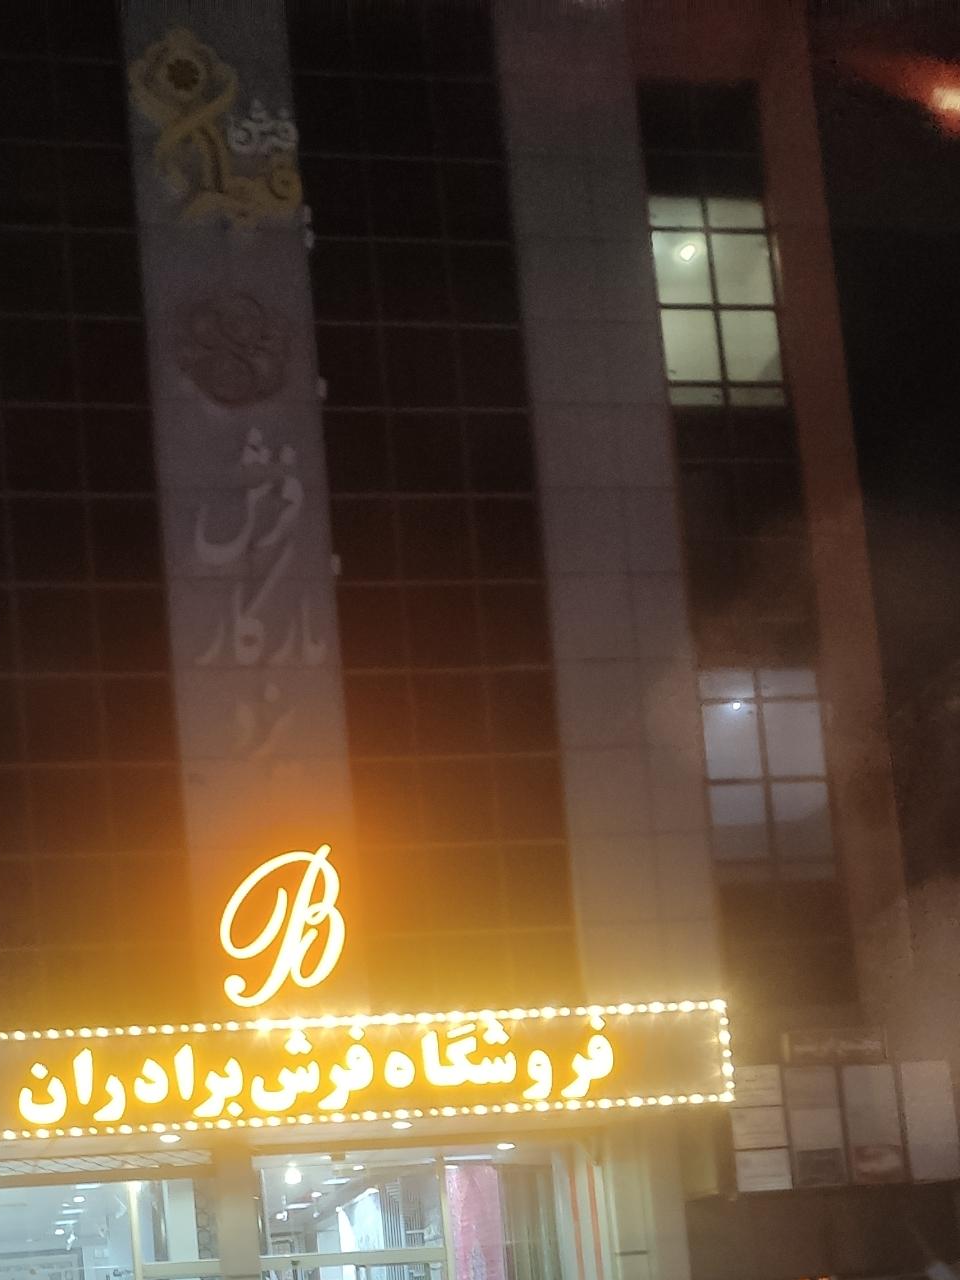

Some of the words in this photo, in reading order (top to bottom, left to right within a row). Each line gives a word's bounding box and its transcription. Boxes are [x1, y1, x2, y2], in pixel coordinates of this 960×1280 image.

[219, 843, 346, 1008] B
[18, 1043, 244, 1125] برادران
[250, 1026, 374, 1112] فرش
[383, 1012, 614, 1101] فروشگاه
